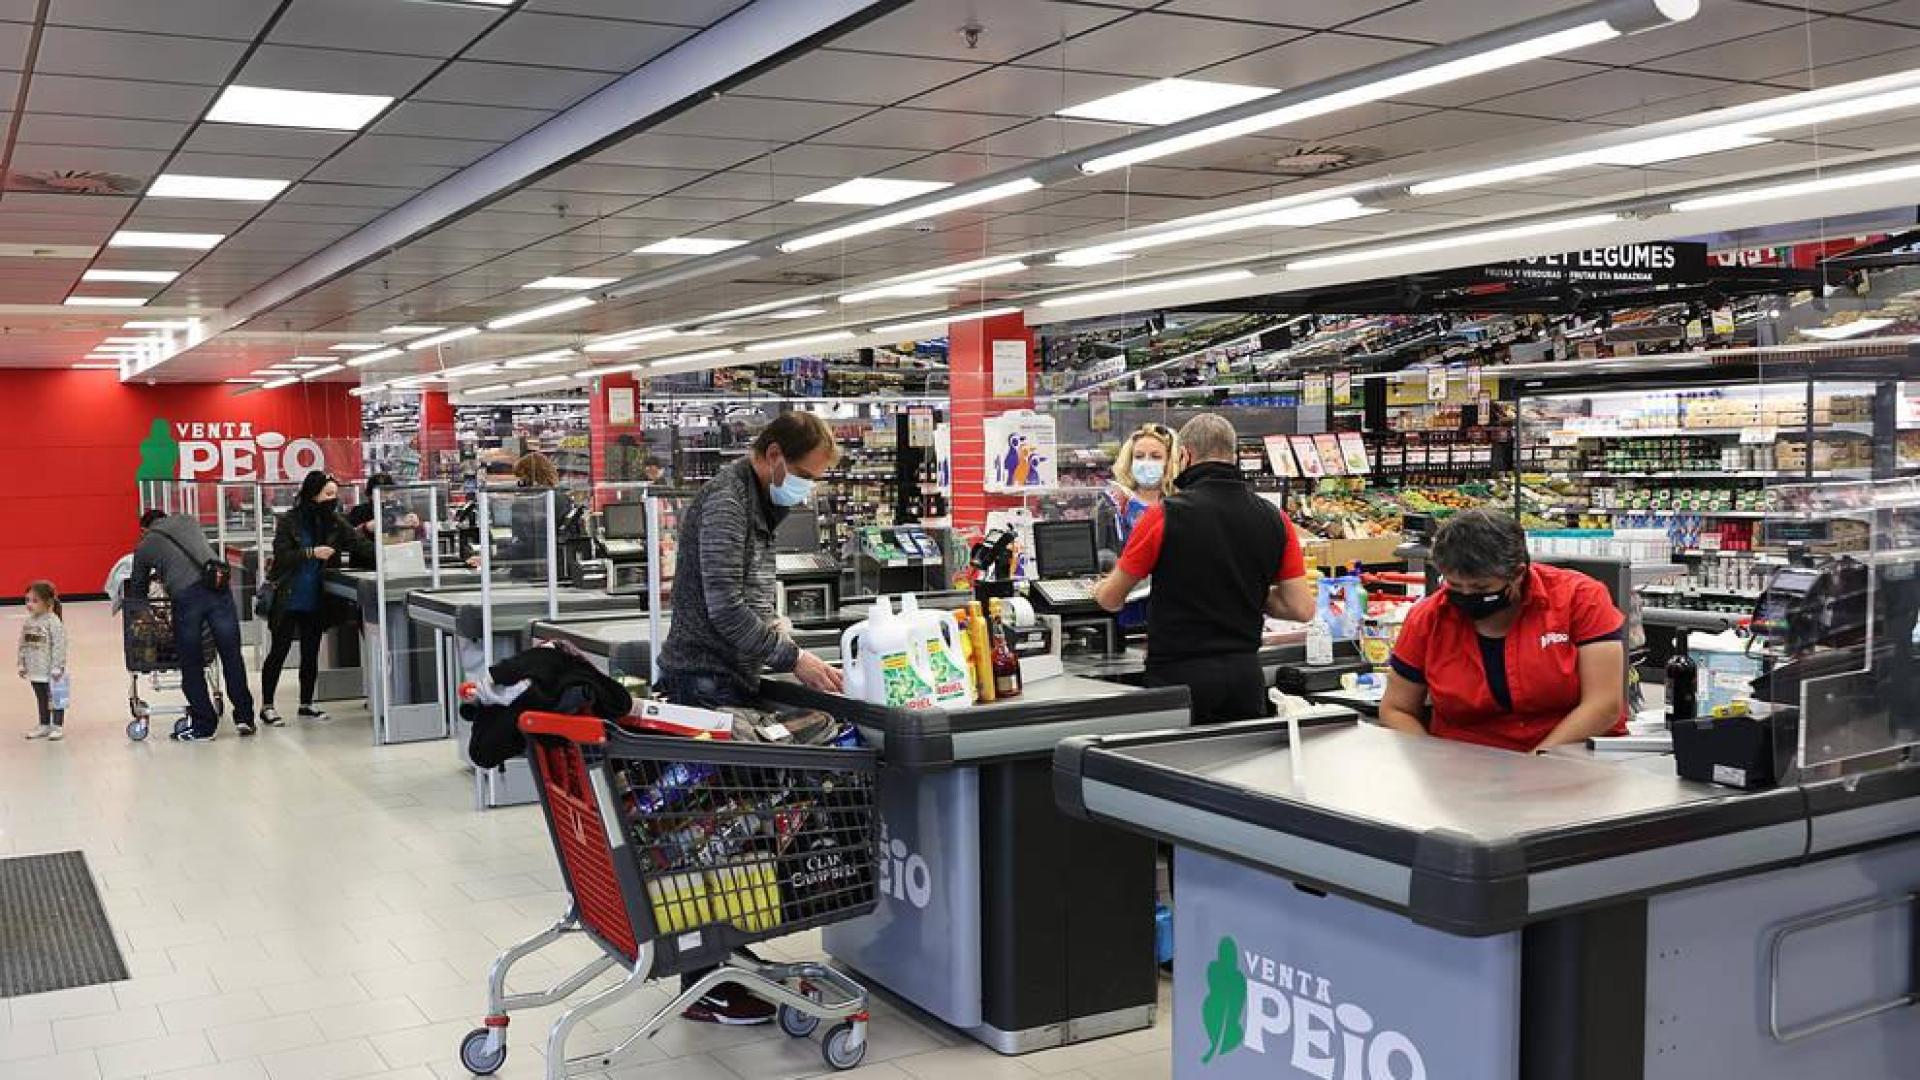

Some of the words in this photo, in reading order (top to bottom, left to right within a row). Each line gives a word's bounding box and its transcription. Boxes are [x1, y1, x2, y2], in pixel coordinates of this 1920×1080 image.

[1579, 245, 1675, 268] LEGUMES
[176, 422, 254, 439] VENTA
[1244, 951, 1332, 1005] VENTA
